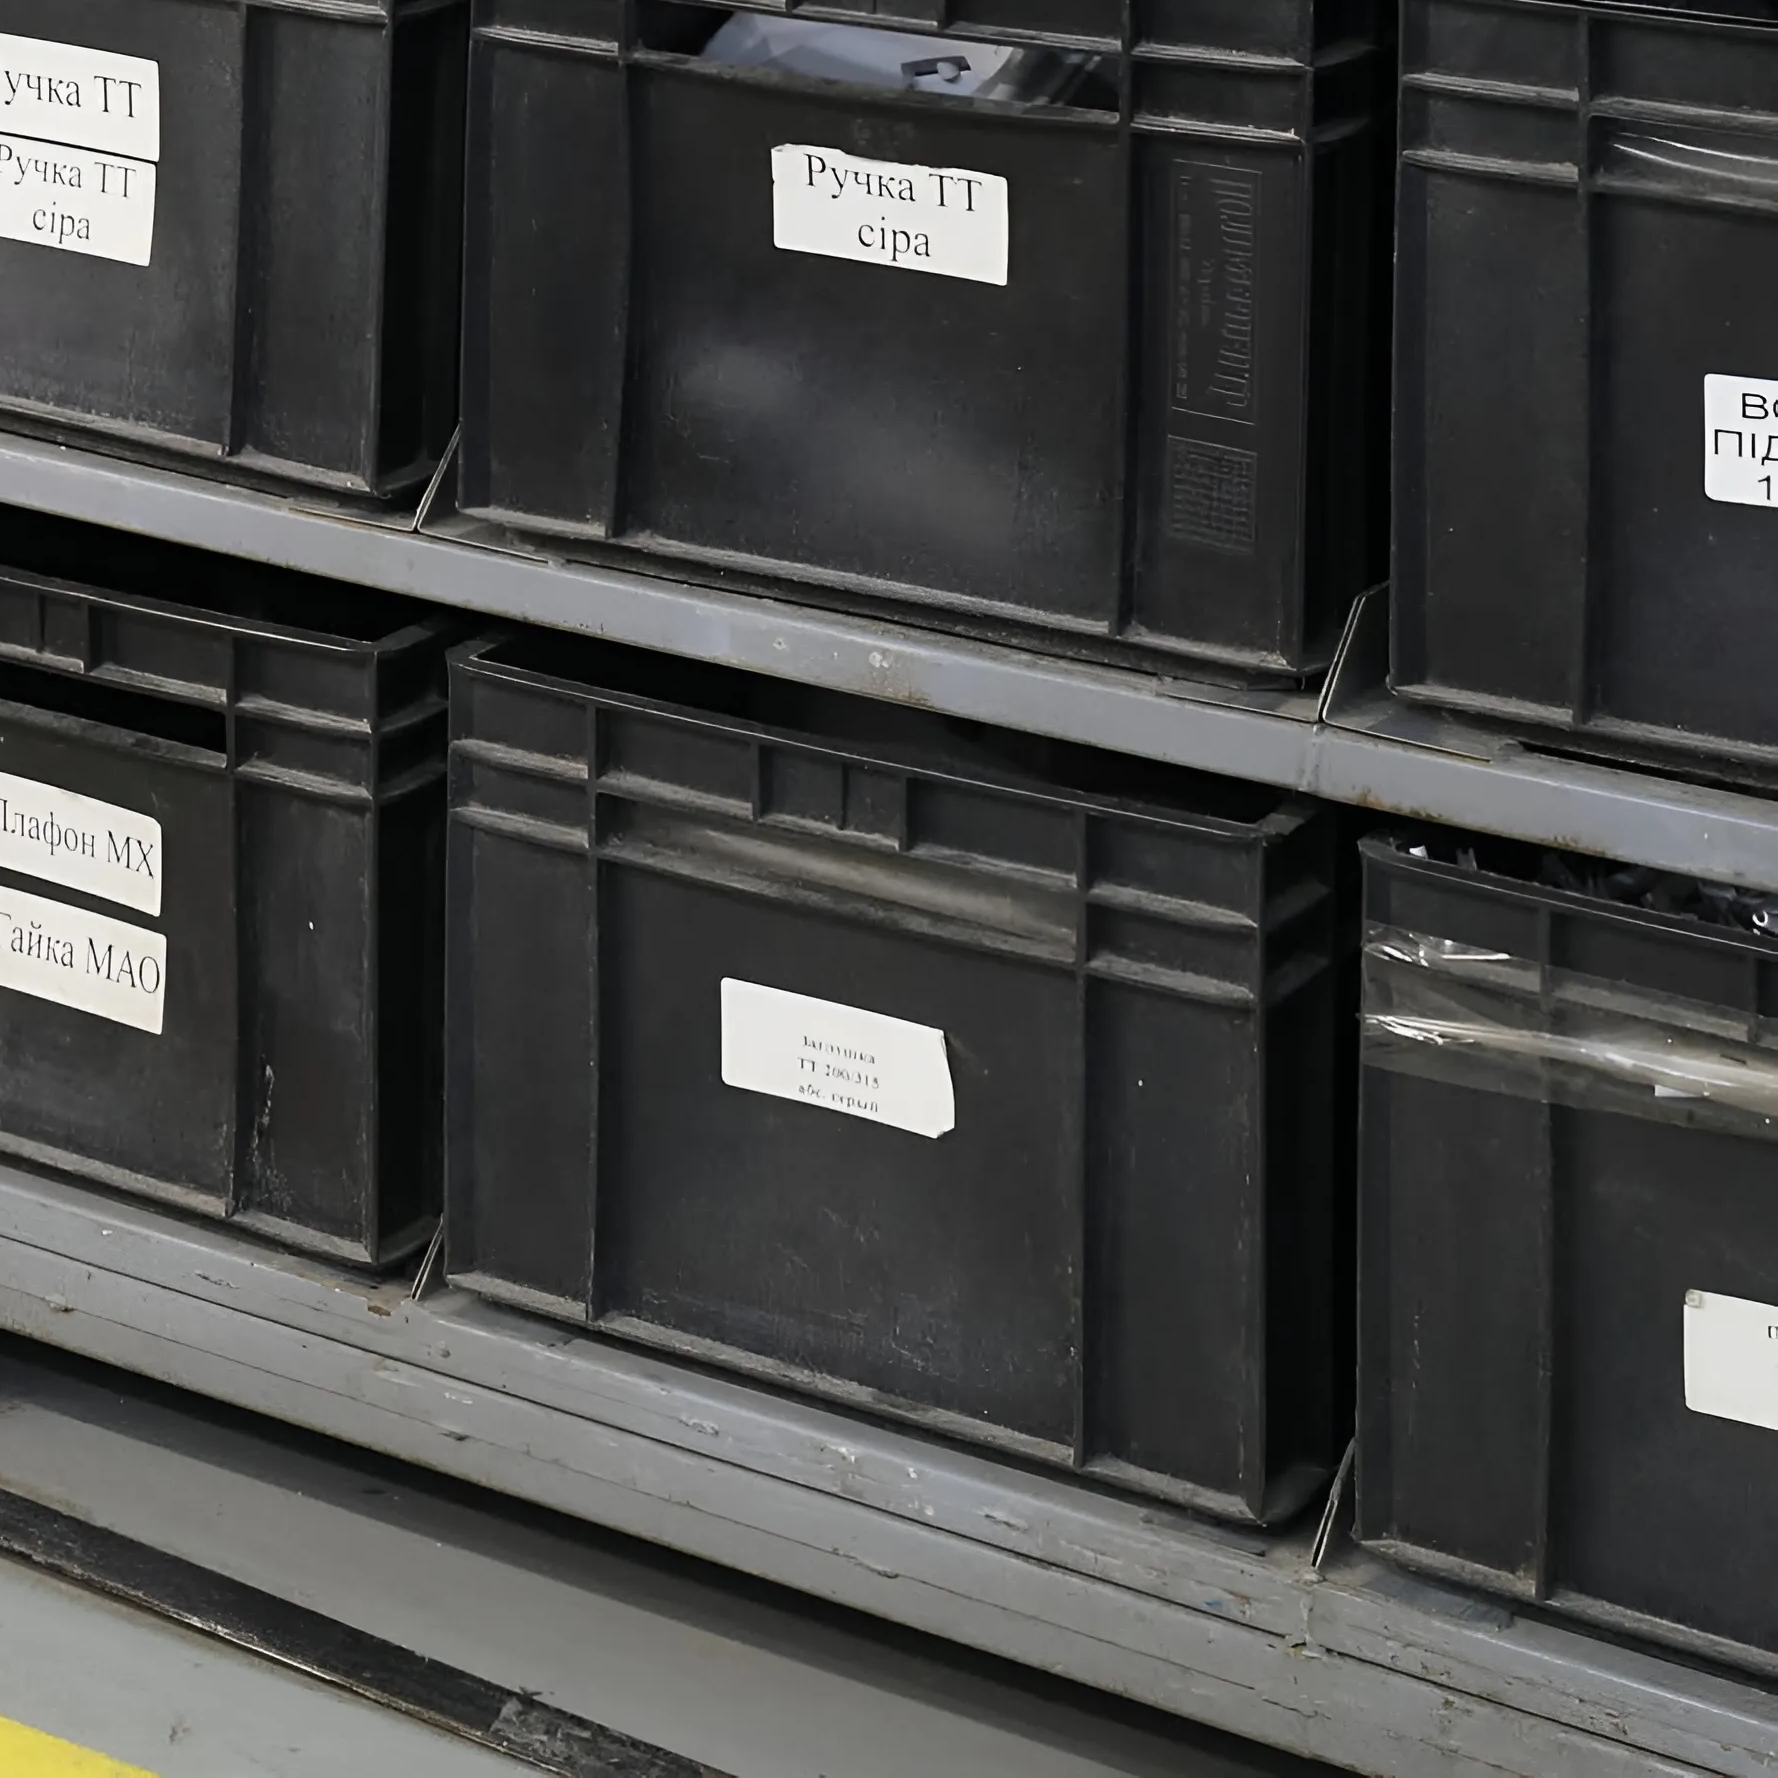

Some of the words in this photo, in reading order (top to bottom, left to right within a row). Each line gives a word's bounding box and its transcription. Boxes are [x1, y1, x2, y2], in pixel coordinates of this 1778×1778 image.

[94, 75, 142, 118] ТТ
[94, 161, 137, 198] ТТ
[803, 153, 916, 202] Ручка
[928, 173, 982, 211] ТТ
[33, 201, 90, 244] сіра
[858, 216, 930, 262] сіра
[1742, 393, 1778, 419] В
[1758, 475, 1771, 500] 1
[107, 830, 154, 879] МХ
[86, 936, 160, 994] МАО
